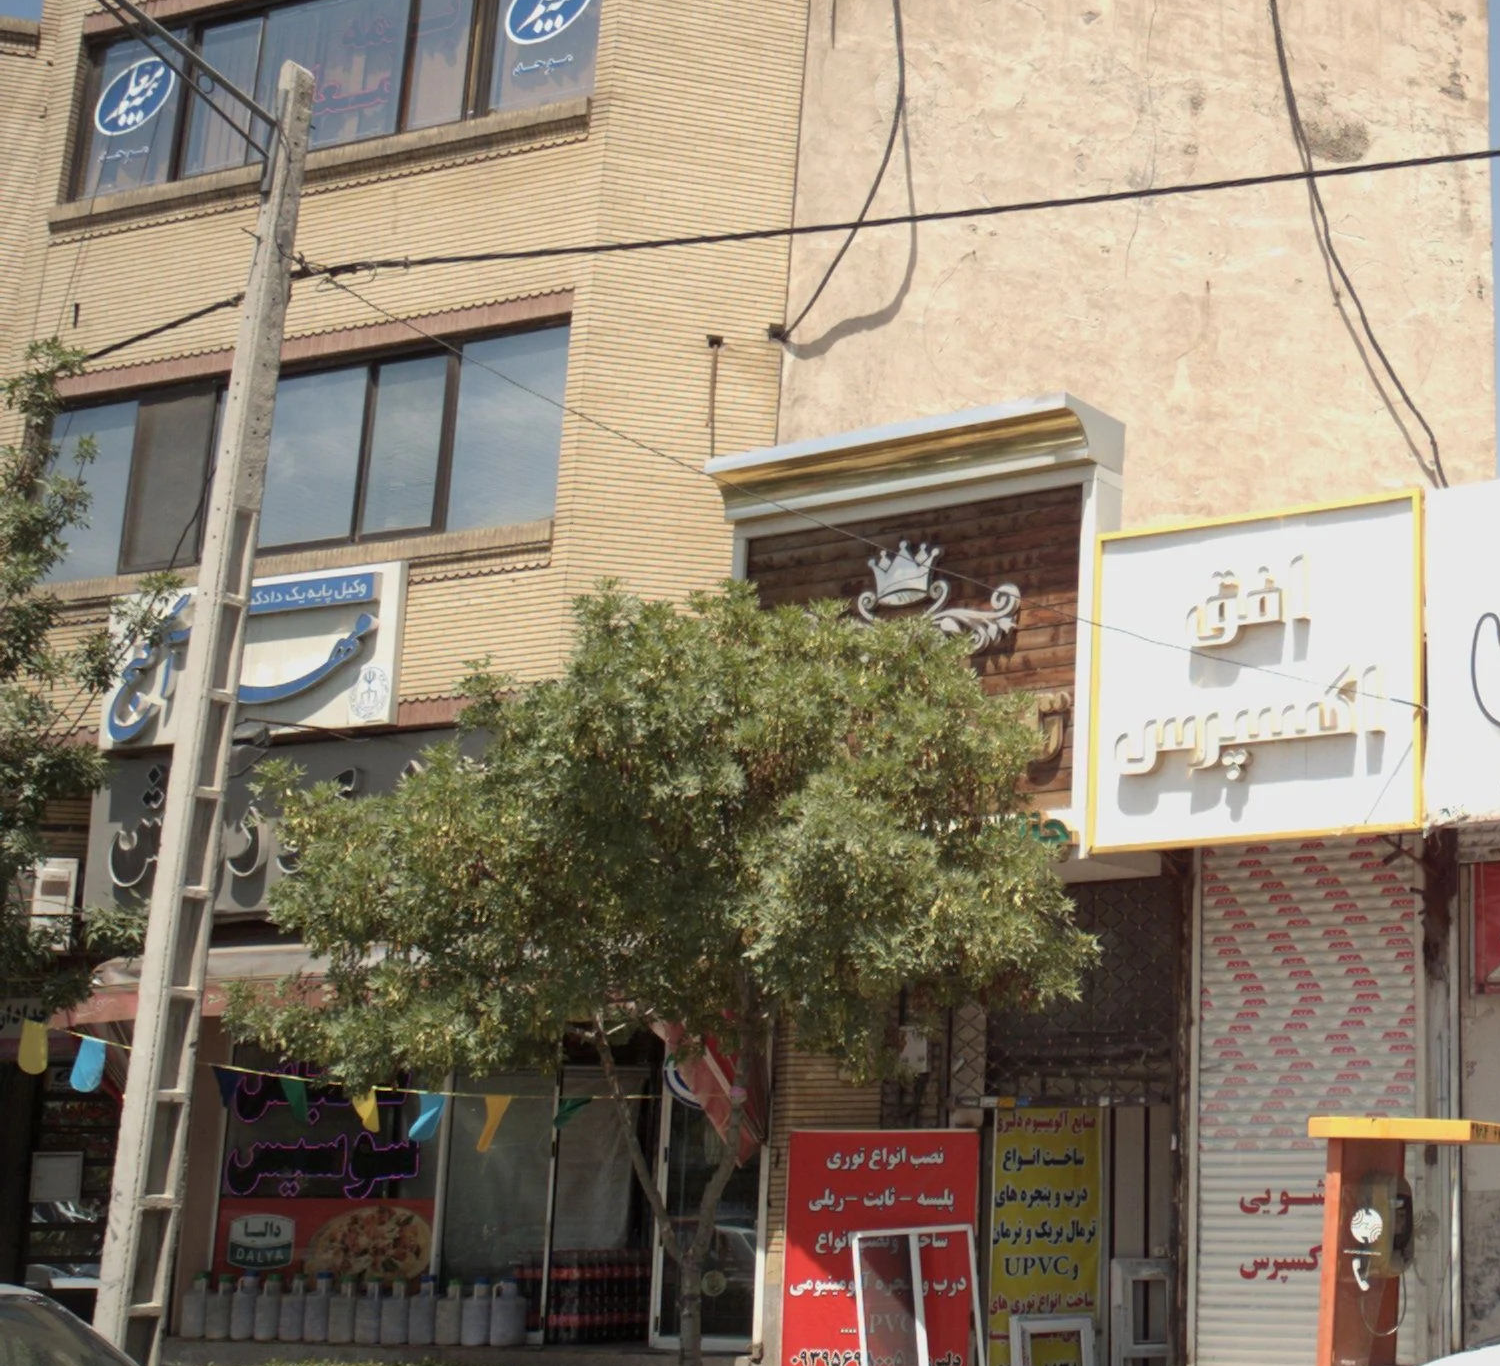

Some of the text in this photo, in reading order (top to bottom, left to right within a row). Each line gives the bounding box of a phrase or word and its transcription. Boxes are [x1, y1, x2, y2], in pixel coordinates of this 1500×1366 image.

[335, 579, 367, 600] وکیل
[225, 1132, 420, 1199] سوسیس
[826, 1147, 944, 1170] نصب انواع توری
[1003, 1148, 1085, 1171] ساخت انواع
[862, 1187, 897, 1211] ثابت
[916, 1188, 955, 1213] پلیسه
[235, 1248, 284, 1263] DALYA
[1240, 1244, 1322, 1283] کسپرس
[932, 1277, 967, 1298] درب
